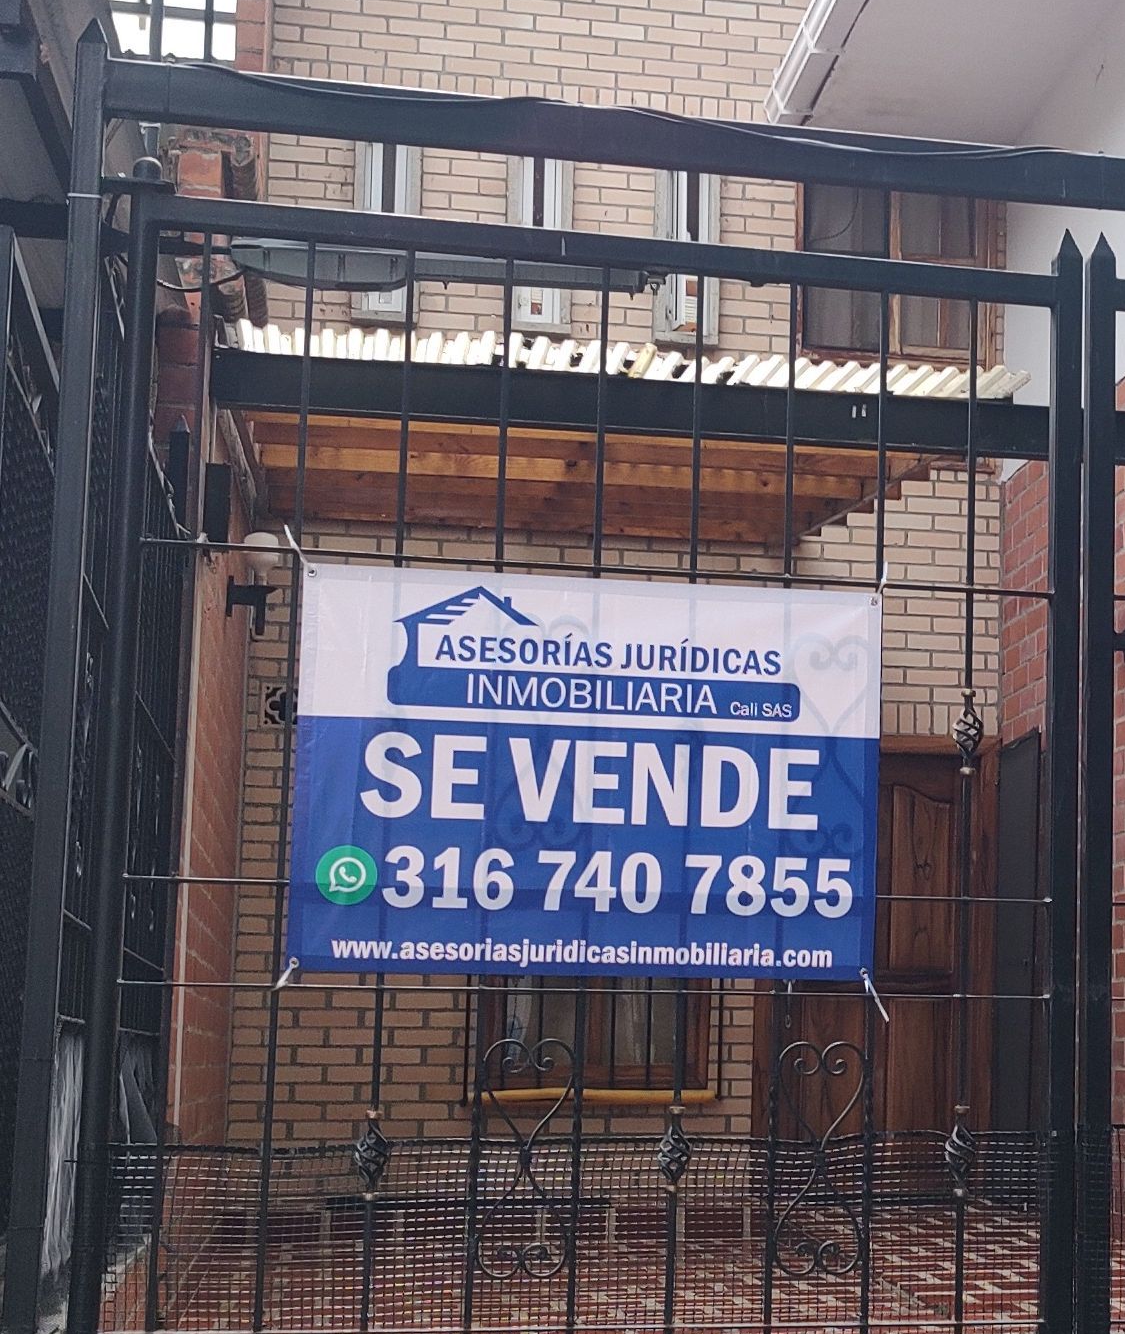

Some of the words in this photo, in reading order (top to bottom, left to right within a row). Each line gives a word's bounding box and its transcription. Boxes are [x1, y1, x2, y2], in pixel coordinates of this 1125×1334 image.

[435, 633, 613, 669] ASESORÍAS
[620, 638, 782, 677] JURÍDICAS
[466, 673, 718, 715] INMOBILIARIA
[729, 700, 759, 718] Cali
[761, 701, 793, 719] SAS
[359, 731, 488, 821] SE
[508, 737, 821, 831] VENDE
[381, 845, 515, 911] 316
[537, 850, 662, 912] 740
[684, 855, 853, 919] 7855
[330, 938, 834, 970] www.asesoriasjuridicasinmobiliaria.com
